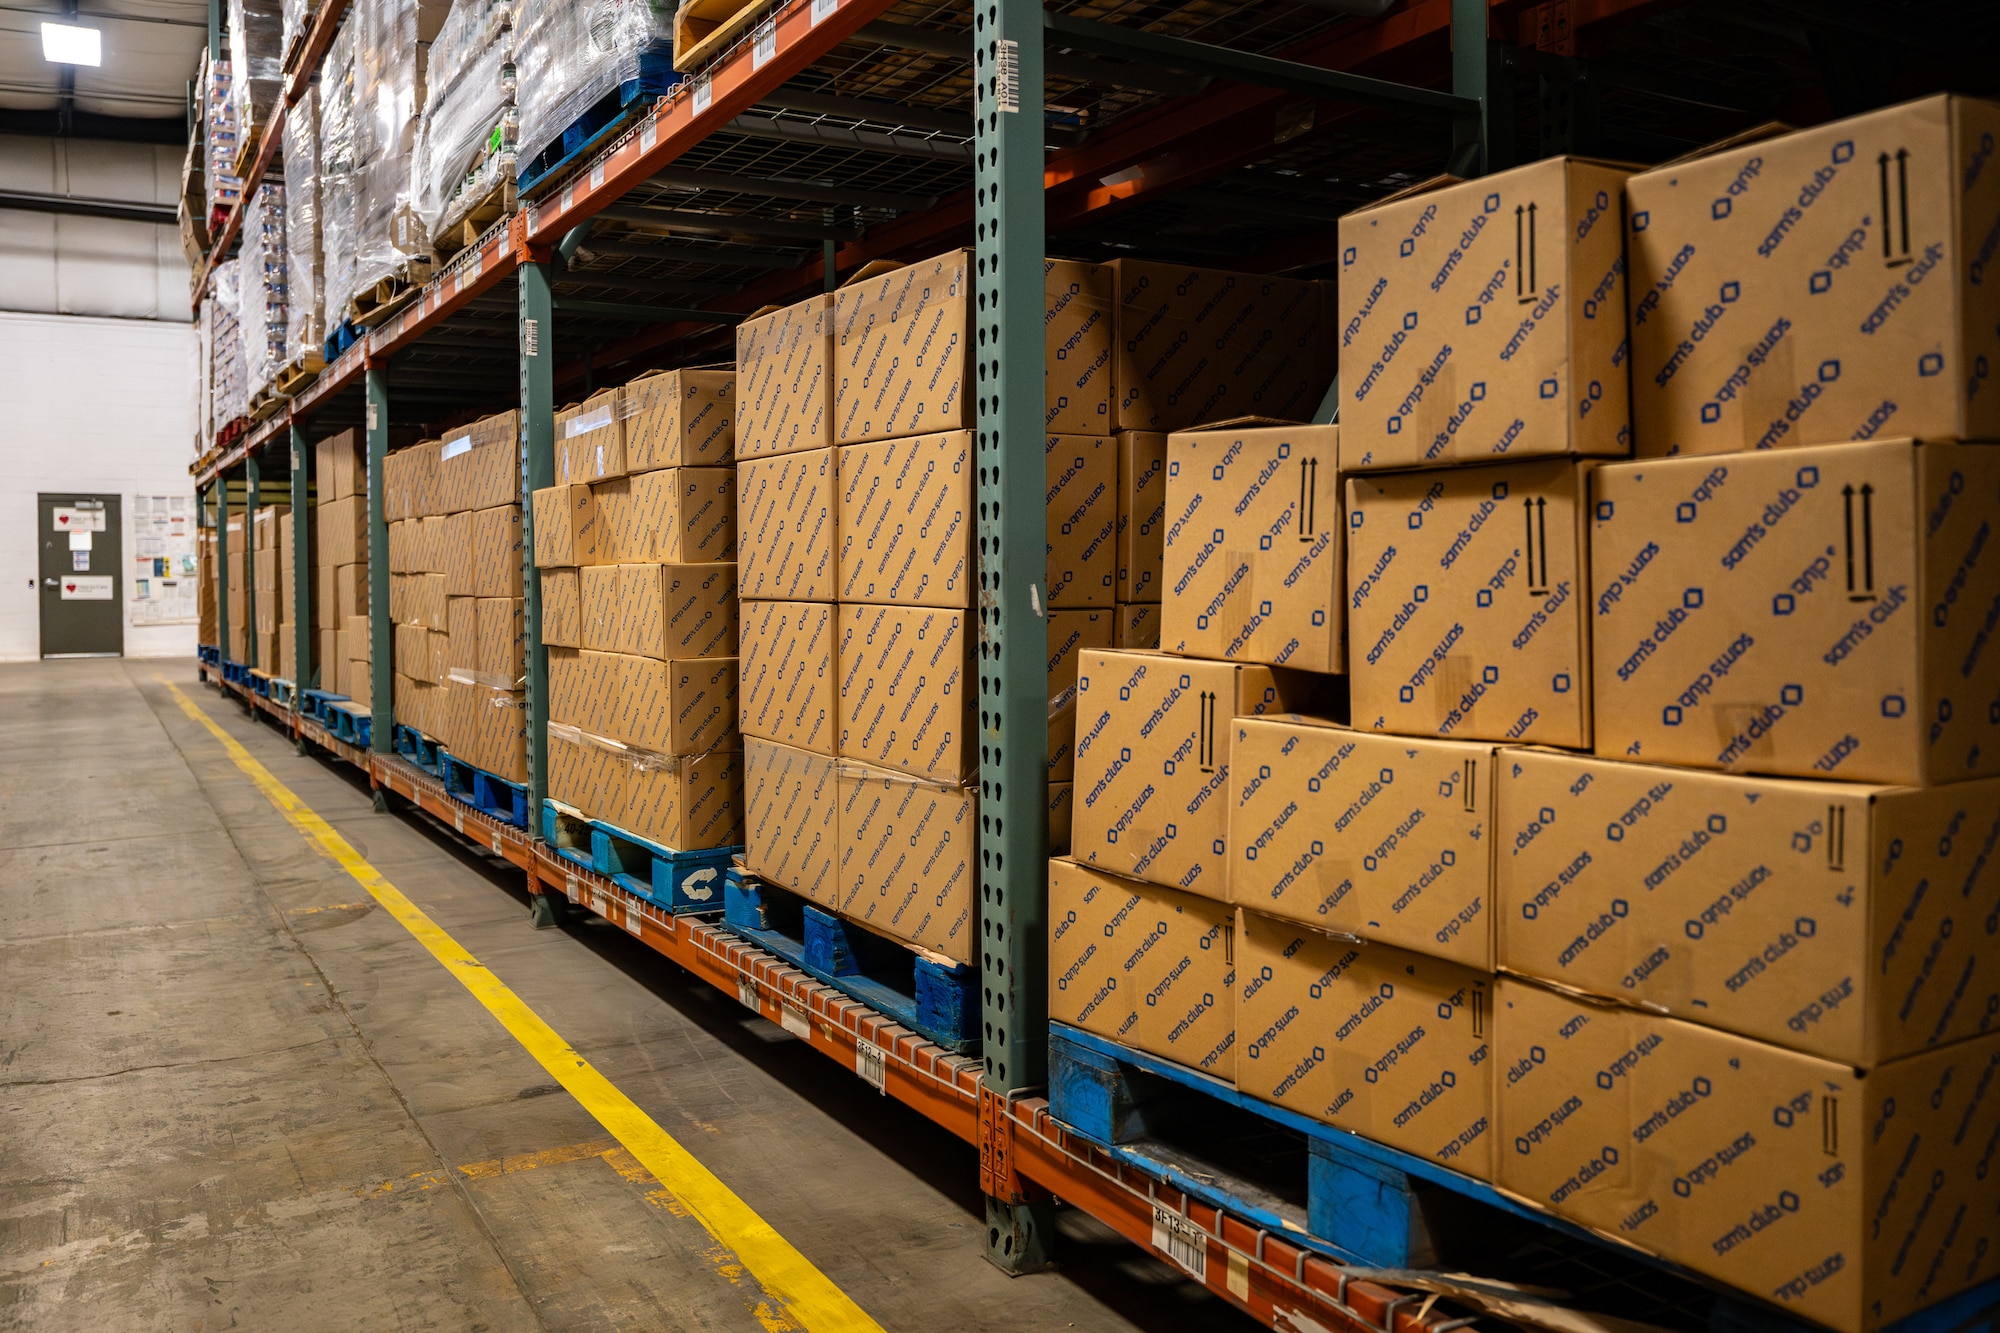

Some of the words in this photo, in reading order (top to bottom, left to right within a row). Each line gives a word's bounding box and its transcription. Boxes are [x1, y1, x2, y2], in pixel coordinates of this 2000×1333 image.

[1727, 157, 1764, 196] club
[1411, 204, 1437, 237] club
[1758, 207, 1802, 258] sam's
[1798, 166, 1837, 208] club
[1431, 248, 1463, 292] sam's
[1460, 215, 1488, 250] club
[1826, 228, 1866, 269] club
[1478, 270, 1506, 304] club
[919, 334, 932, 357] club
[941, 342, 954, 366] club
[1655, 332, 1694, 388] sam's
[1691, 300, 1725, 342] club
[1746, 318, 1792, 367] sam's
[864, 358, 876, 380] club
[885, 365, 898, 388] club
[1355, 361, 1384, 401] sam's
[1382, 331, 1407, 362] club
[1420, 345, 1452, 386] sam's
[1715, 364, 1751, 402] club
[1398, 384, 1424, 416] club
[1222, 440, 1242, 465] club
[919, 469, 933, 492] club
[1235, 484, 1260, 516] sam's
[1258, 456, 1281, 486] club
[1692, 467, 1728, 502] club
[1418, 482, 1444, 512] club
[869, 521, 881, 541] club
[922, 508, 936, 529] club
[945, 519, 960, 542] club
[1269, 510, 1292, 538] club
[1721, 523, 1766, 570] sam's
[1762, 484, 1802, 526] club
[1440, 530, 1472, 570] sam's
[1469, 500, 1496, 532] club
[1174, 565, 1197, 596] sam's
[1196, 543, 1216, 568] club
[1224, 562, 1248, 594] sam's
[1488, 558, 1516, 590] club
[1790, 557, 1830, 594] club
[1204, 592, 1226, 618] club
[888, 631, 900, 651] club
[942, 624, 958, 646] club
[1367, 628, 1395, 665] sam's
[1393, 602, 1418, 631] club
[1433, 623, 1464, 661] sam's
[1617, 638, 1657, 681] sam's
[1653, 605, 1689, 642] club
[1710, 633, 1754, 677] sam's
[890, 669, 903, 688] club
[1128, 666, 1146, 688] club
[1410, 658, 1436, 686] club
[1678, 674, 1713, 707] club
[1140, 709, 1163, 739] sam's
[1162, 688, 1181, 712] club
[1172, 738, 1192, 762] club
[1086, 780, 1106, 808] sam's
[1105, 760, 1123, 783] club
[1132, 784, 1154, 812] sam's
[1242, 778, 1262, 800] club
[1115, 810, 1133, 832] club
[1273, 802, 1298, 830] sam's
[1334, 803, 1361, 832] sam's
[1360, 782, 1383, 806] club
[912, 820, 925, 838] club
[1255, 828, 1274, 848] club
[1396, 809, 1425, 838] sam's
[934, 838, 950, 858] club
[1374, 834, 1398, 858] club
[938, 880, 952, 898] club
[1271, 872, 1294, 899] sam's
[1292, 854, 1314, 876] club
[1392, 884, 1421, 914] sam's
[1419, 864, 1444, 888] club
[1055, 921, 1070, 939] club
[1436, 919, 1460, 943] club
[1078, 944, 1096, 966] sam's
[1124, 948, 1144, 972] sam's
[1142, 932, 1160, 952] club
[1063, 962, 1079, 982] club
[1170, 956, 1191, 980] sam's
[1152, 977, 1171, 998] club
[1244, 978, 1264, 999] club
[1077, 1002, 1095, 1024] sam's
[1094, 988, 1109, 1006] club
[1275, 1006, 1299, 1031] sam's
[1336, 1014, 1362, 1041] sam's
[1360, 996, 1384, 1018] club
[1168, 1020, 1189, 1043] sam's
[1188, 1004, 1206, 1024] club
[1254, 1028, 1276, 1049] club
[1396, 1026, 1426, 1054] sam's
[1372, 1050, 1398, 1074] club
[1273, 1074, 1296, 1098] sam's
[1295, 1058, 1315, 1079] club
[1393, 1101, 1422, 1128] sam's
[1420, 1084, 1445, 1106] club
